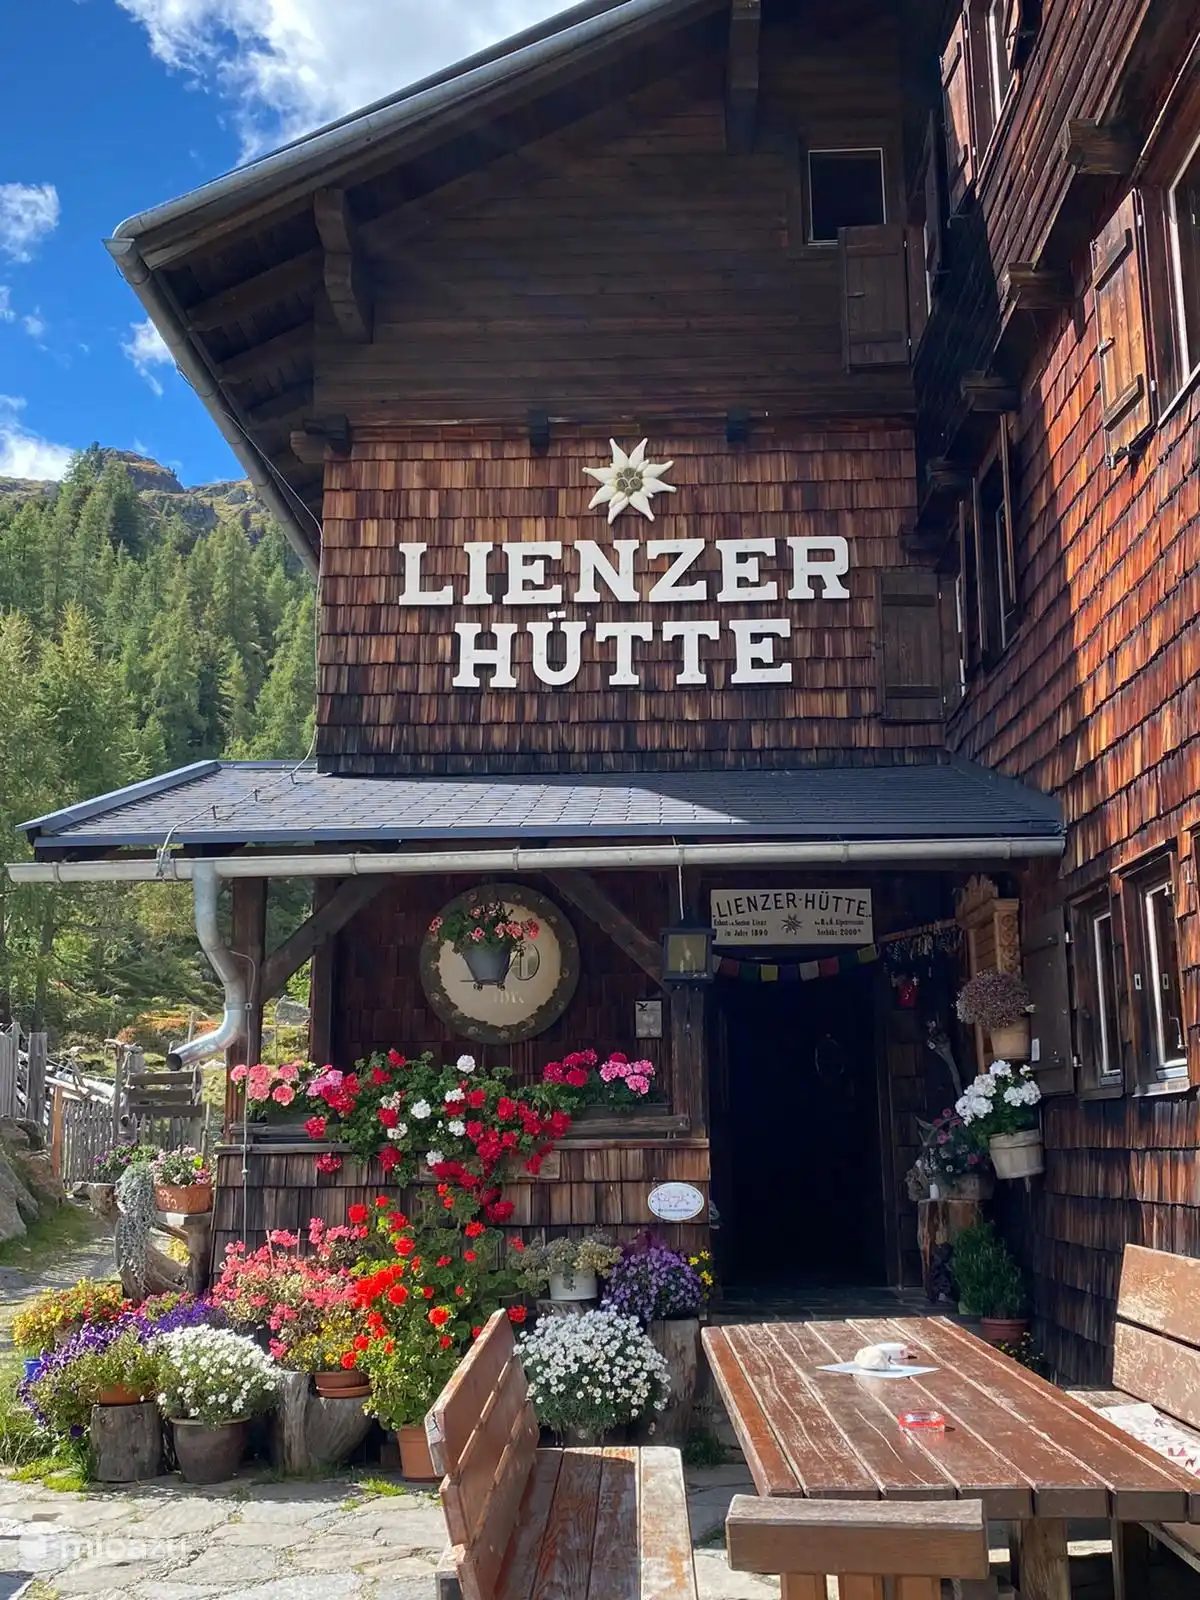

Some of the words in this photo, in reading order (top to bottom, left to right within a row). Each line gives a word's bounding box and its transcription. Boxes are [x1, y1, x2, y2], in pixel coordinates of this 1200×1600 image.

[398, 536, 850, 605] LIENZER
[452, 610, 793, 688] HÜTTE
[751, 929, 769, 937] 1890
